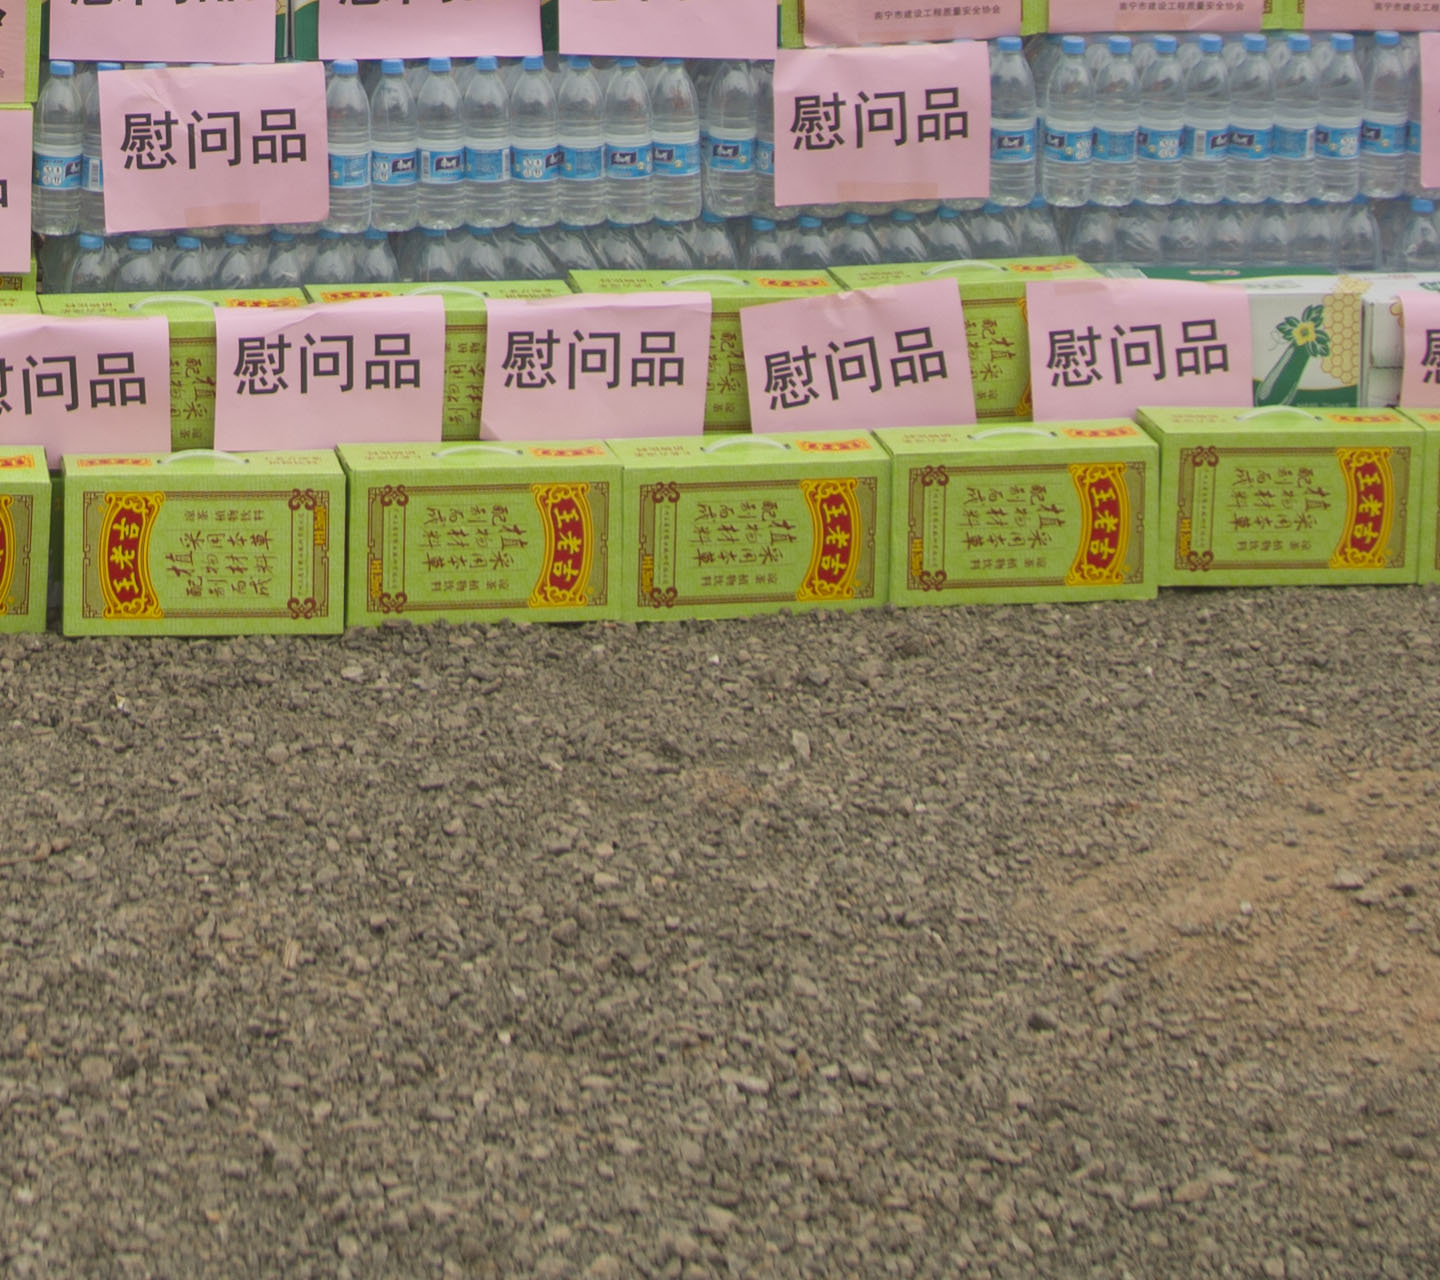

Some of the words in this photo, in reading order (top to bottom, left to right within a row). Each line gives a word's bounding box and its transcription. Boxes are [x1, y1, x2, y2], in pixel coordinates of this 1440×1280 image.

[874, 4, 1001, 21] 南宁市建设工程质量安全协会
[1119, 0, 1244, 11] 南宁市建设工程质量安全协会
[120, 109, 306, 169] 慰问品
[790, 88, 968, 150] 慰问品
[234, 334, 420, 395] 慰问品
[502, 330, 684, 389] 慰问品
[765, 327, 947, 410] 慰问品
[1047, 320, 1228, 387] 慰问品
[1091, 482, 1121, 558] 王老吉
[1353, 468, 1381, 552] 王老吉
[112, 521, 140, 605] 王老吉
[552, 508, 579, 593] 王老吉
[820, 507, 850, 588] 王老吉
